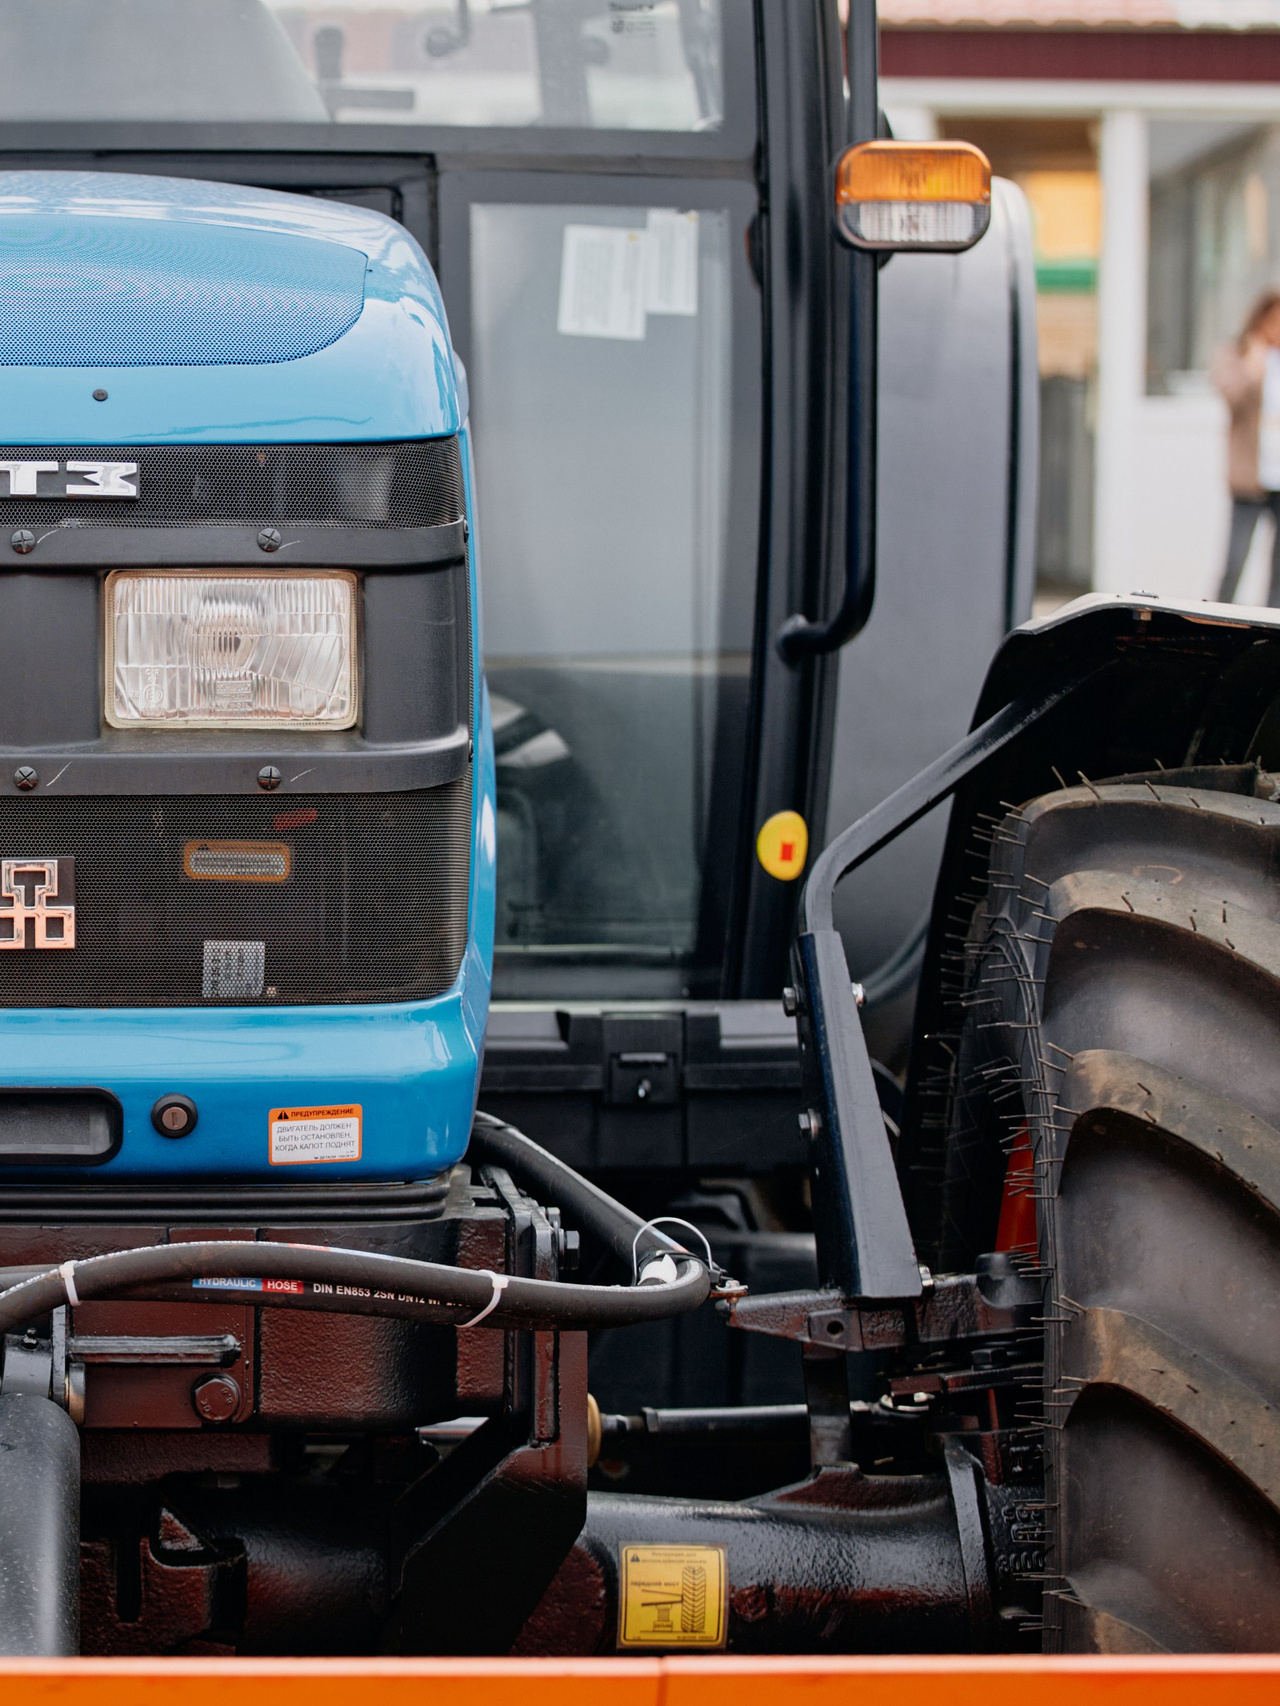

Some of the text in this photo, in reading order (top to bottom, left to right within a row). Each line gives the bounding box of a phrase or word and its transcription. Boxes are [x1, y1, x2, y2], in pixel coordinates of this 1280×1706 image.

[291, 1108, 354, 1117] ПРЕДУПРЕЖДЕНИЕ
[276, 1123, 352, 1134] ДВИГАТЕЛЬ ДОЛЖЕН
[275, 1140, 355, 1152] КОГДА КАПОТ ПОДНЯТ
[267, 1279, 298, 1291] HOSE
[313, 1282, 333, 1294] DIN
[336, 1284, 371, 1298] EN853
